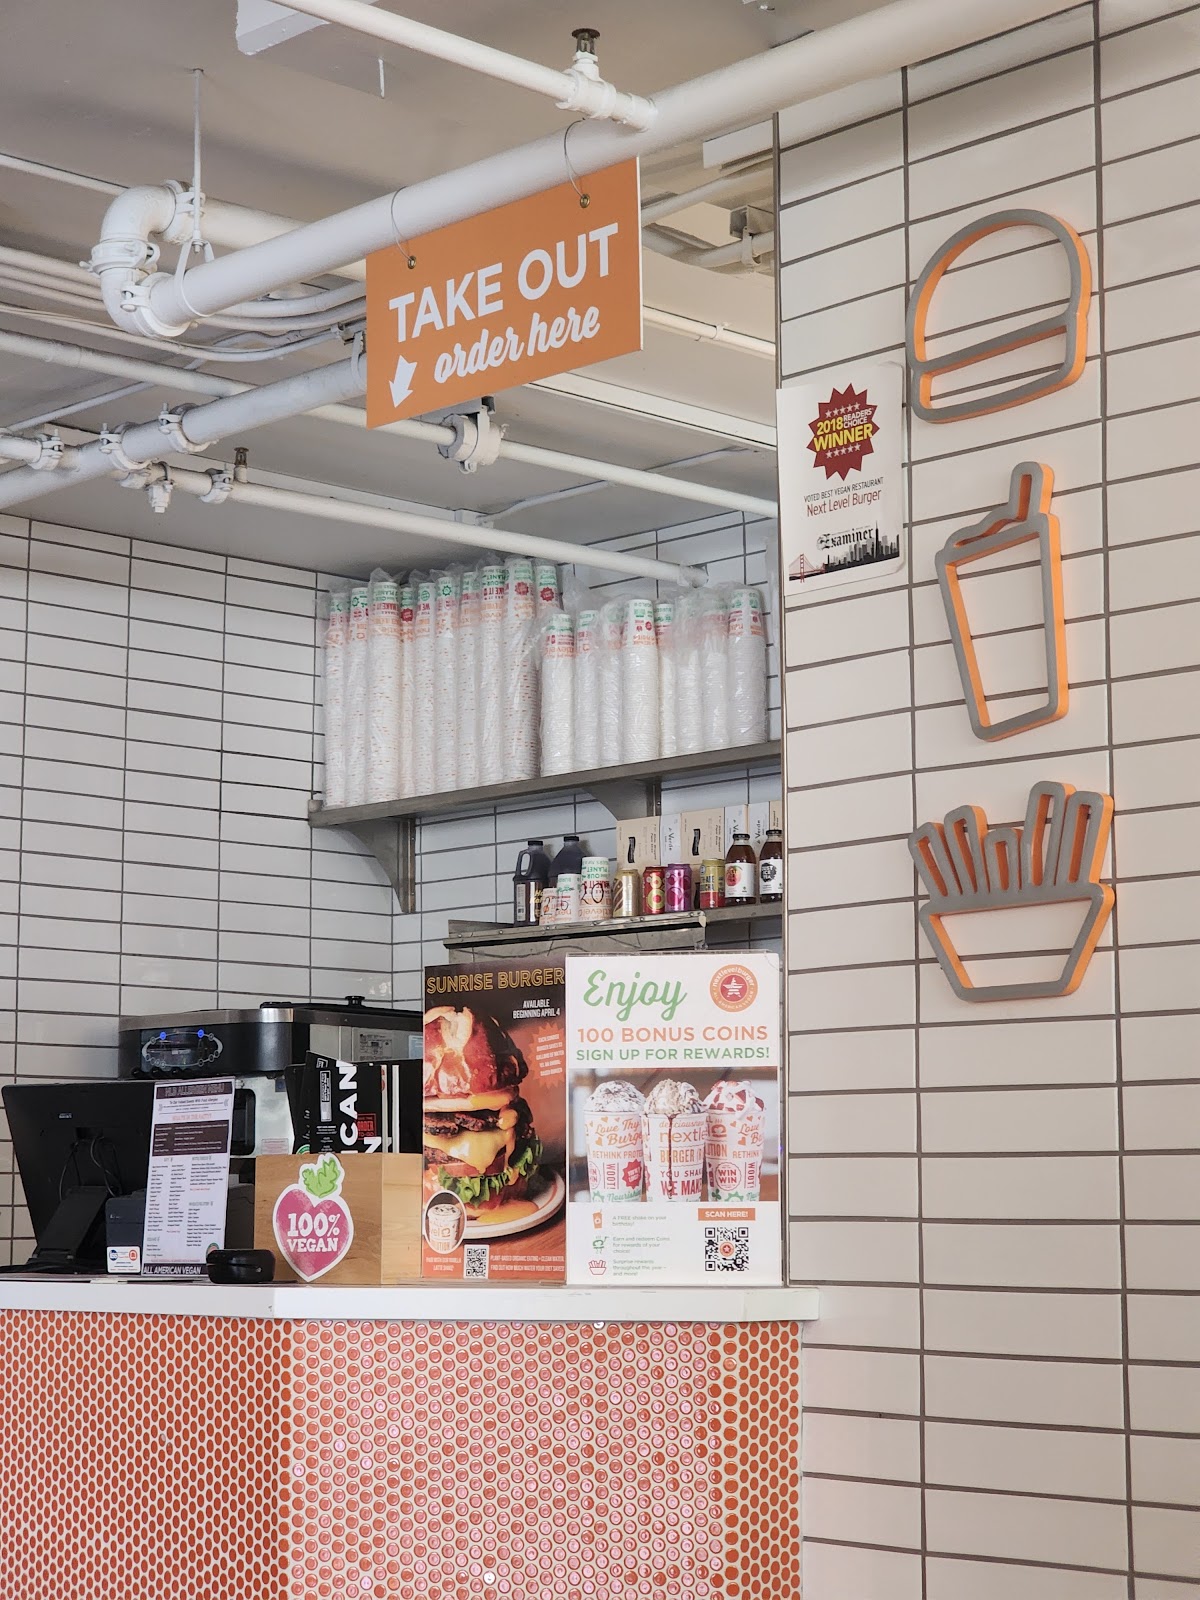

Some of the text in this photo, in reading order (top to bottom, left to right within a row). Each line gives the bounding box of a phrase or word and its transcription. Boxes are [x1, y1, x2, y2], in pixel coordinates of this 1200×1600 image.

[388, 222, 619, 343] TAKE OUT
[433, 306, 601, 384] order here
[816, 416, 844, 436] 2018
[843, 416, 868, 429] CHOICE
[813, 423, 873, 452] WINNER
[803, 476, 884, 503] VOTED BEST VEGAN RESTAURANT
[806, 490, 882, 517] Next Level Burger
[816, 528, 874, 551] Examiner
[426, 967, 565, 994] SUNRISE BURGER
[712, 966, 756, 988] nextlevelburger
[523, 999, 550, 1009] AVAILABLE
[583, 968, 688, 1022] Enjoy
[512, 1007, 561, 1019] BEGINNING APRIL 4
[577, 1025, 769, 1043] 100 BONUS COINS
[576, 1046, 770, 1061] SIGN UP FOR REWARDS!
[622, 1117, 641, 1132] Thy
[592, 1150, 622, 1159] RETHINK
[606, 1163, 616, 1190] WOOT!
[719, 1176, 738, 1184] WIN
[704, 1210, 749, 1218] SCAN HERE!
[287, 1212, 341, 1238] 100%
[287, 1237, 339, 1253] VEGAN
[143, 1265, 202, 1275] ALL AMERICAN VEGAN
